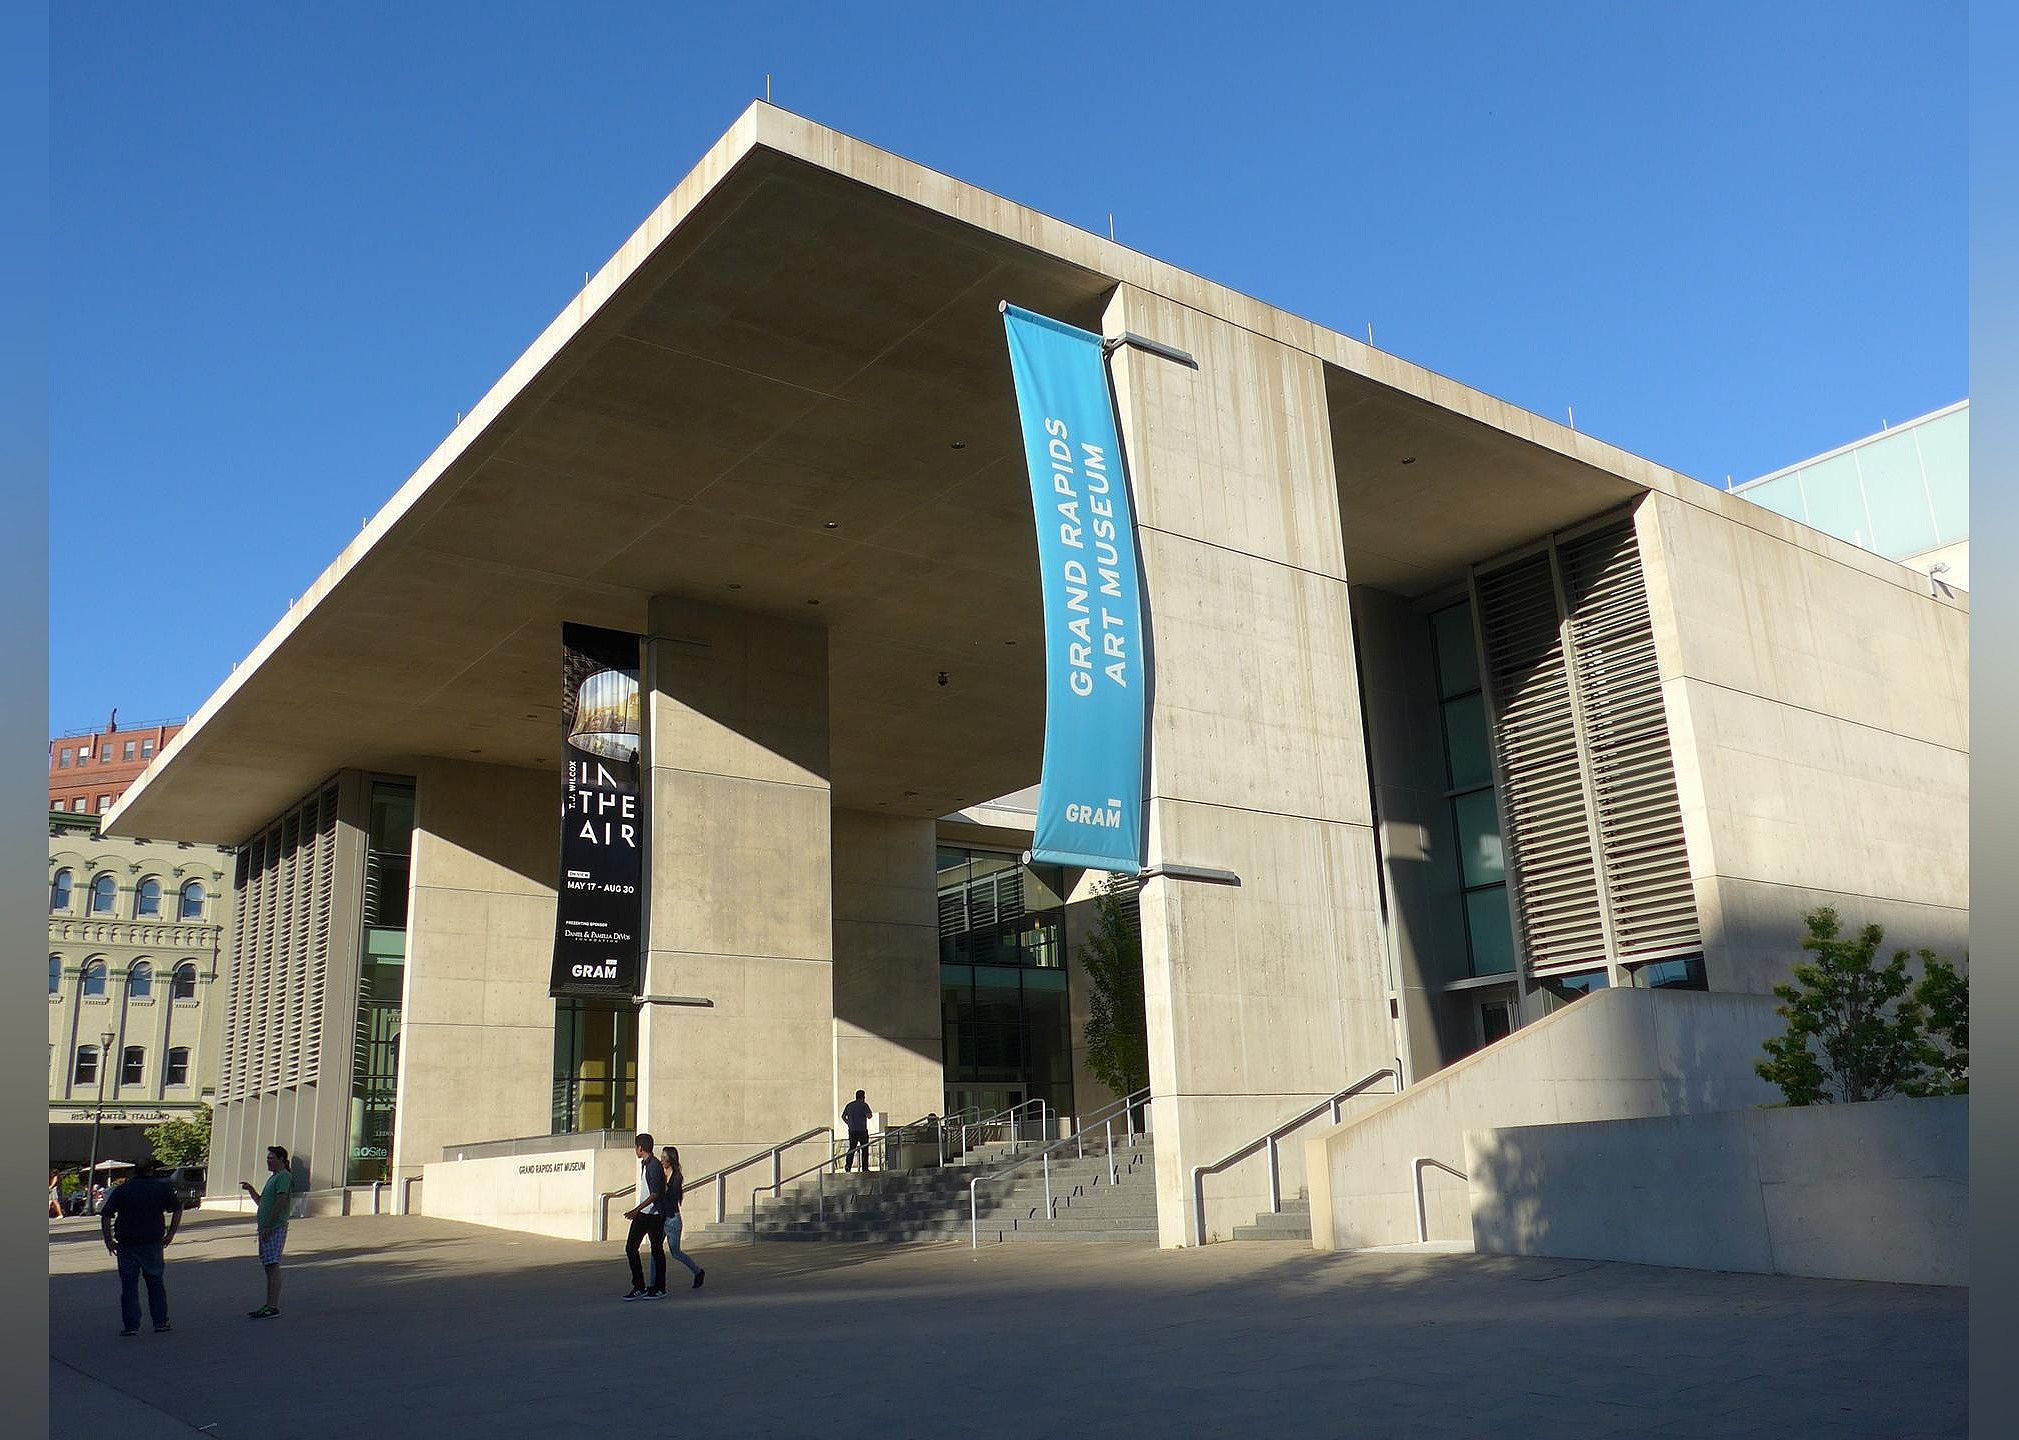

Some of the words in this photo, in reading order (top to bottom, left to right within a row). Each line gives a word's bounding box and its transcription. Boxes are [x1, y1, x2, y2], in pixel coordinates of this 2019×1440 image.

[1044, 417, 1084, 549] RAPIDS
[1080, 442, 1122, 598] MUSEUM
[1064, 559, 1094, 697] GRAND
[1102, 607, 1127, 689] ART
[568, 760, 577, 792] WILCOX
[582, 761, 617, 789] IN
[568, 793, 576, 810] T.J.
[578, 790, 635, 818] THE
[1065, 803, 1121, 829] GRAM
[579, 819, 636, 848] AIR
[567, 880, 586, 890] MAY
[587, 882, 597, 891] 17
[603, 884, 622, 893] AUG
[622, 885, 635, 894] 30
[571, 964, 617, 979] GRAM
[519, 1165, 535, 1175] GRAND
[535, 1164, 553, 1174] RAPIDS
[553, 1162, 564, 1172] ART
[564, 1161, 586, 1172] MUSEUM
